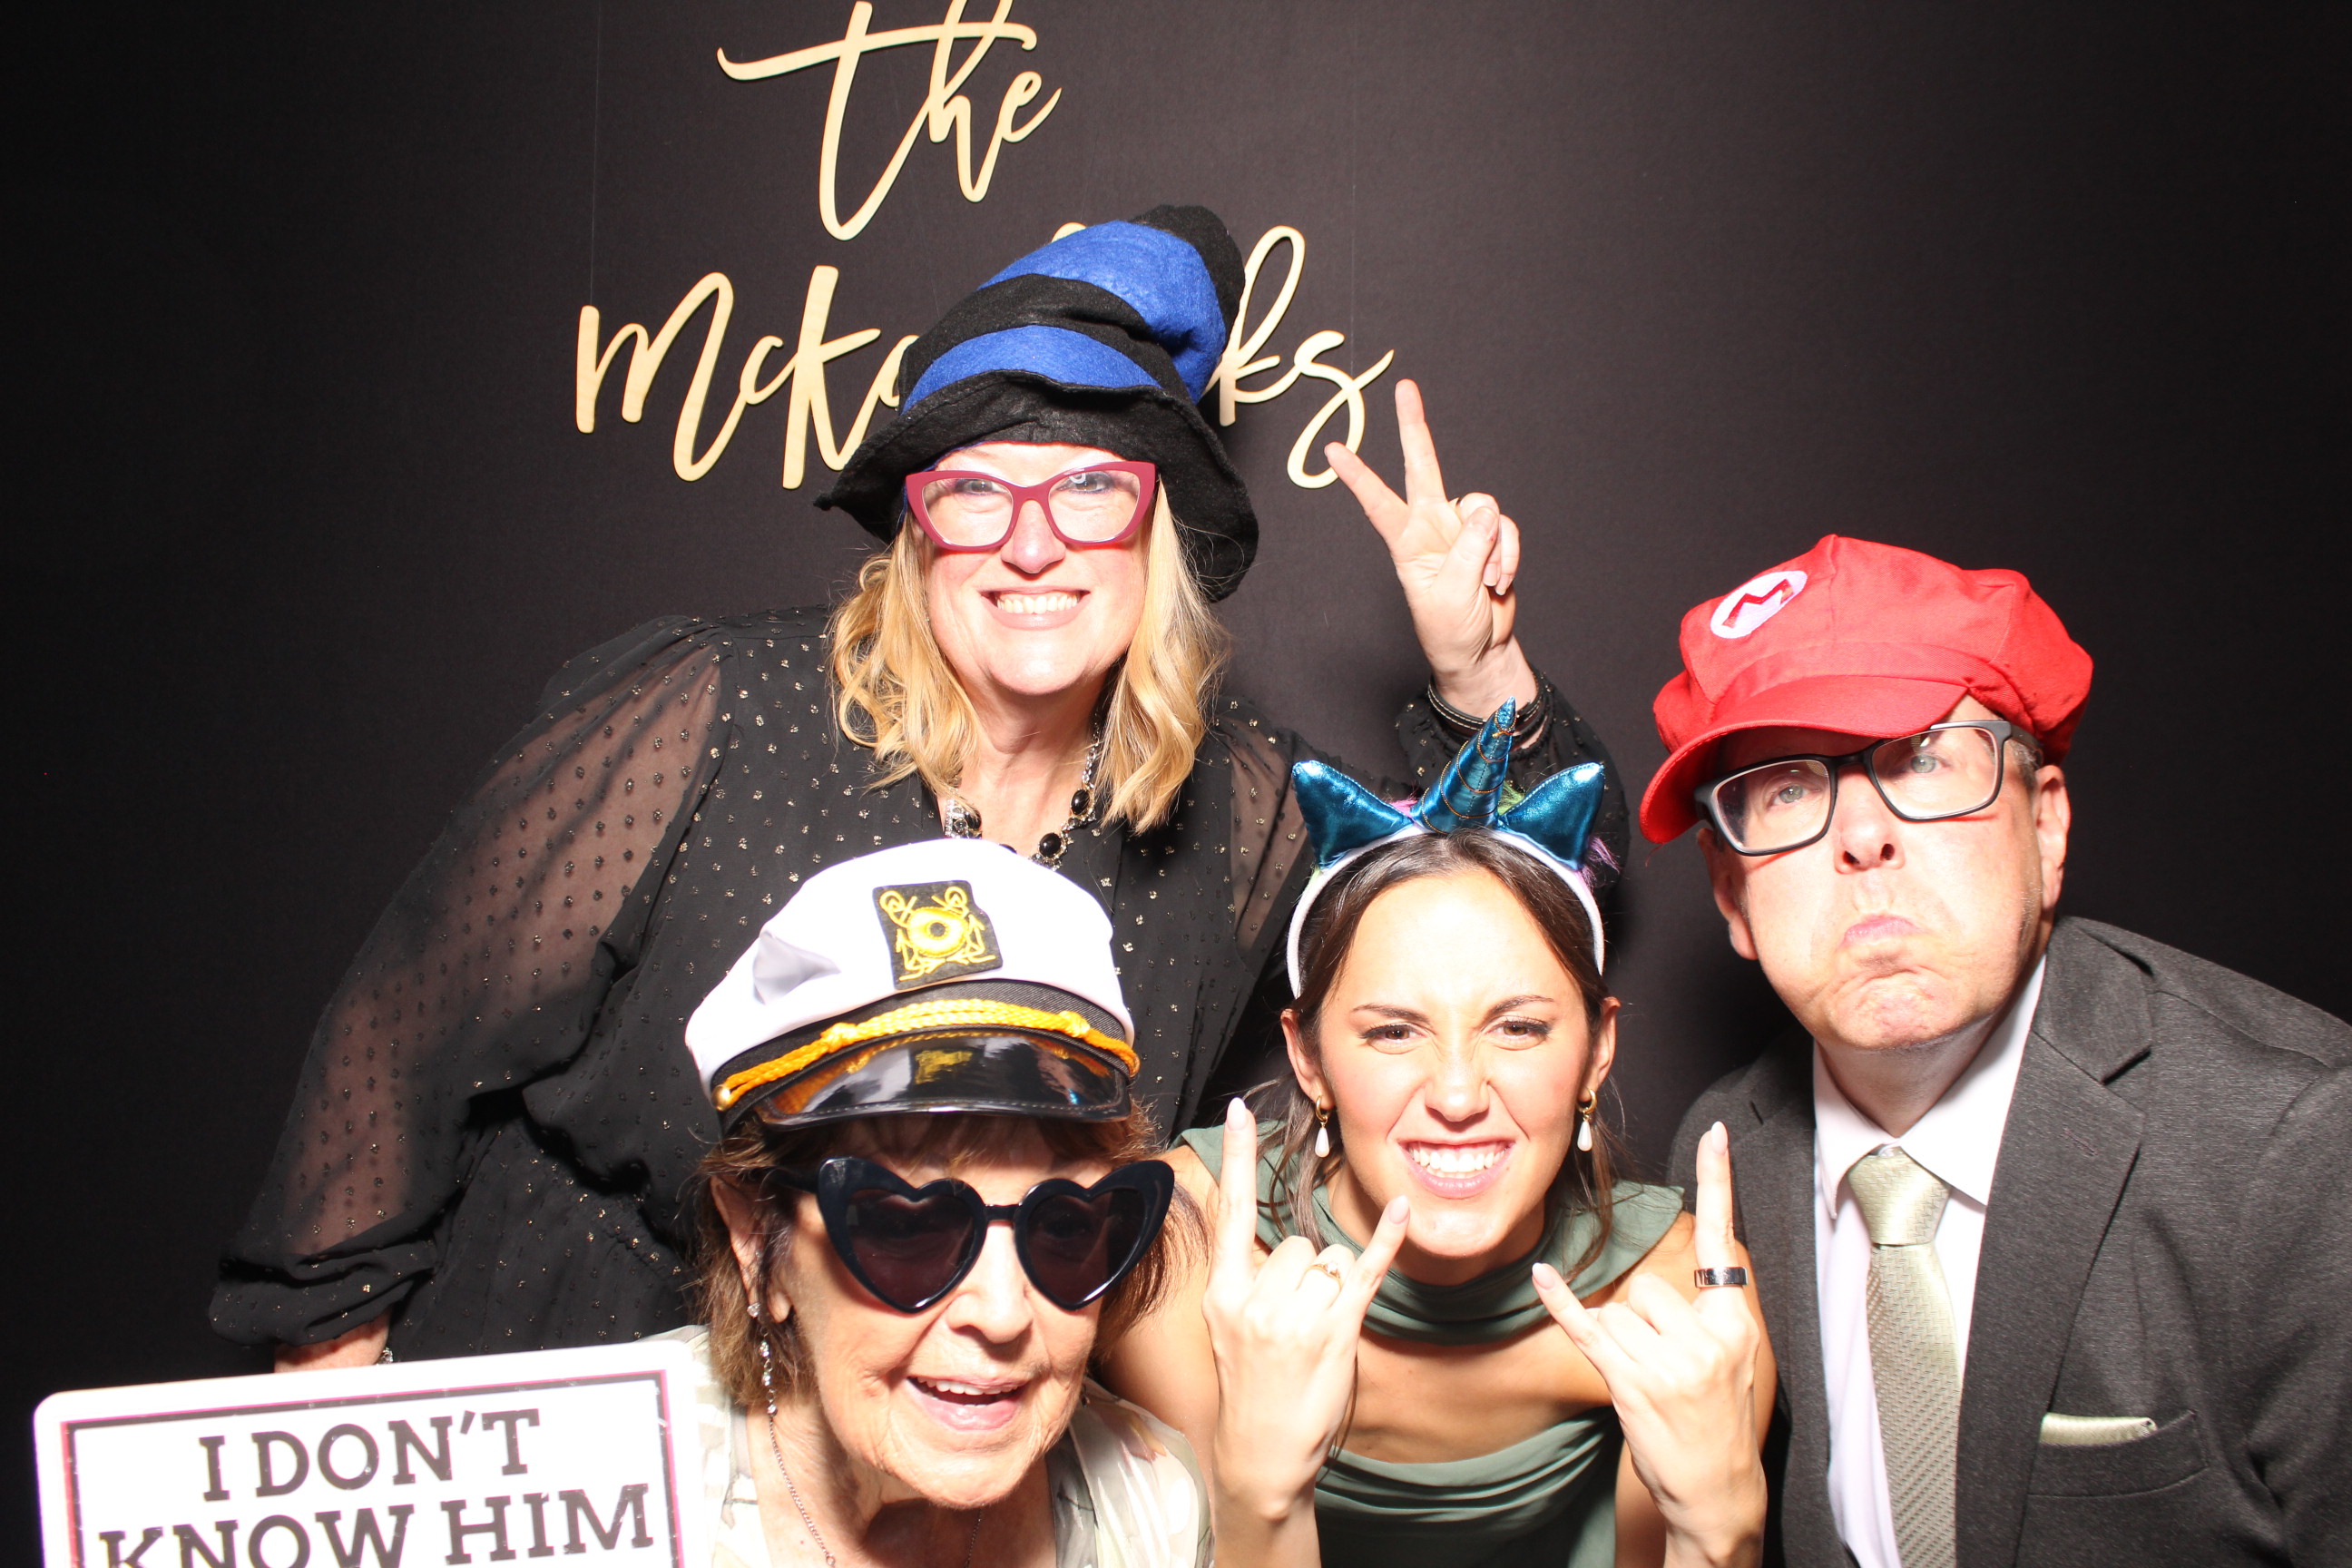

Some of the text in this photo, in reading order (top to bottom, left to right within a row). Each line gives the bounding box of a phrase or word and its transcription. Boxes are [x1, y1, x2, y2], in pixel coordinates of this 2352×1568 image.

[716, 0, 1063, 241] the
[1721, 578, 1796, 629] M
[199, 1407, 540, 1502] I DON'T
[99, 1483, 654, 1568] KNOW HIM
